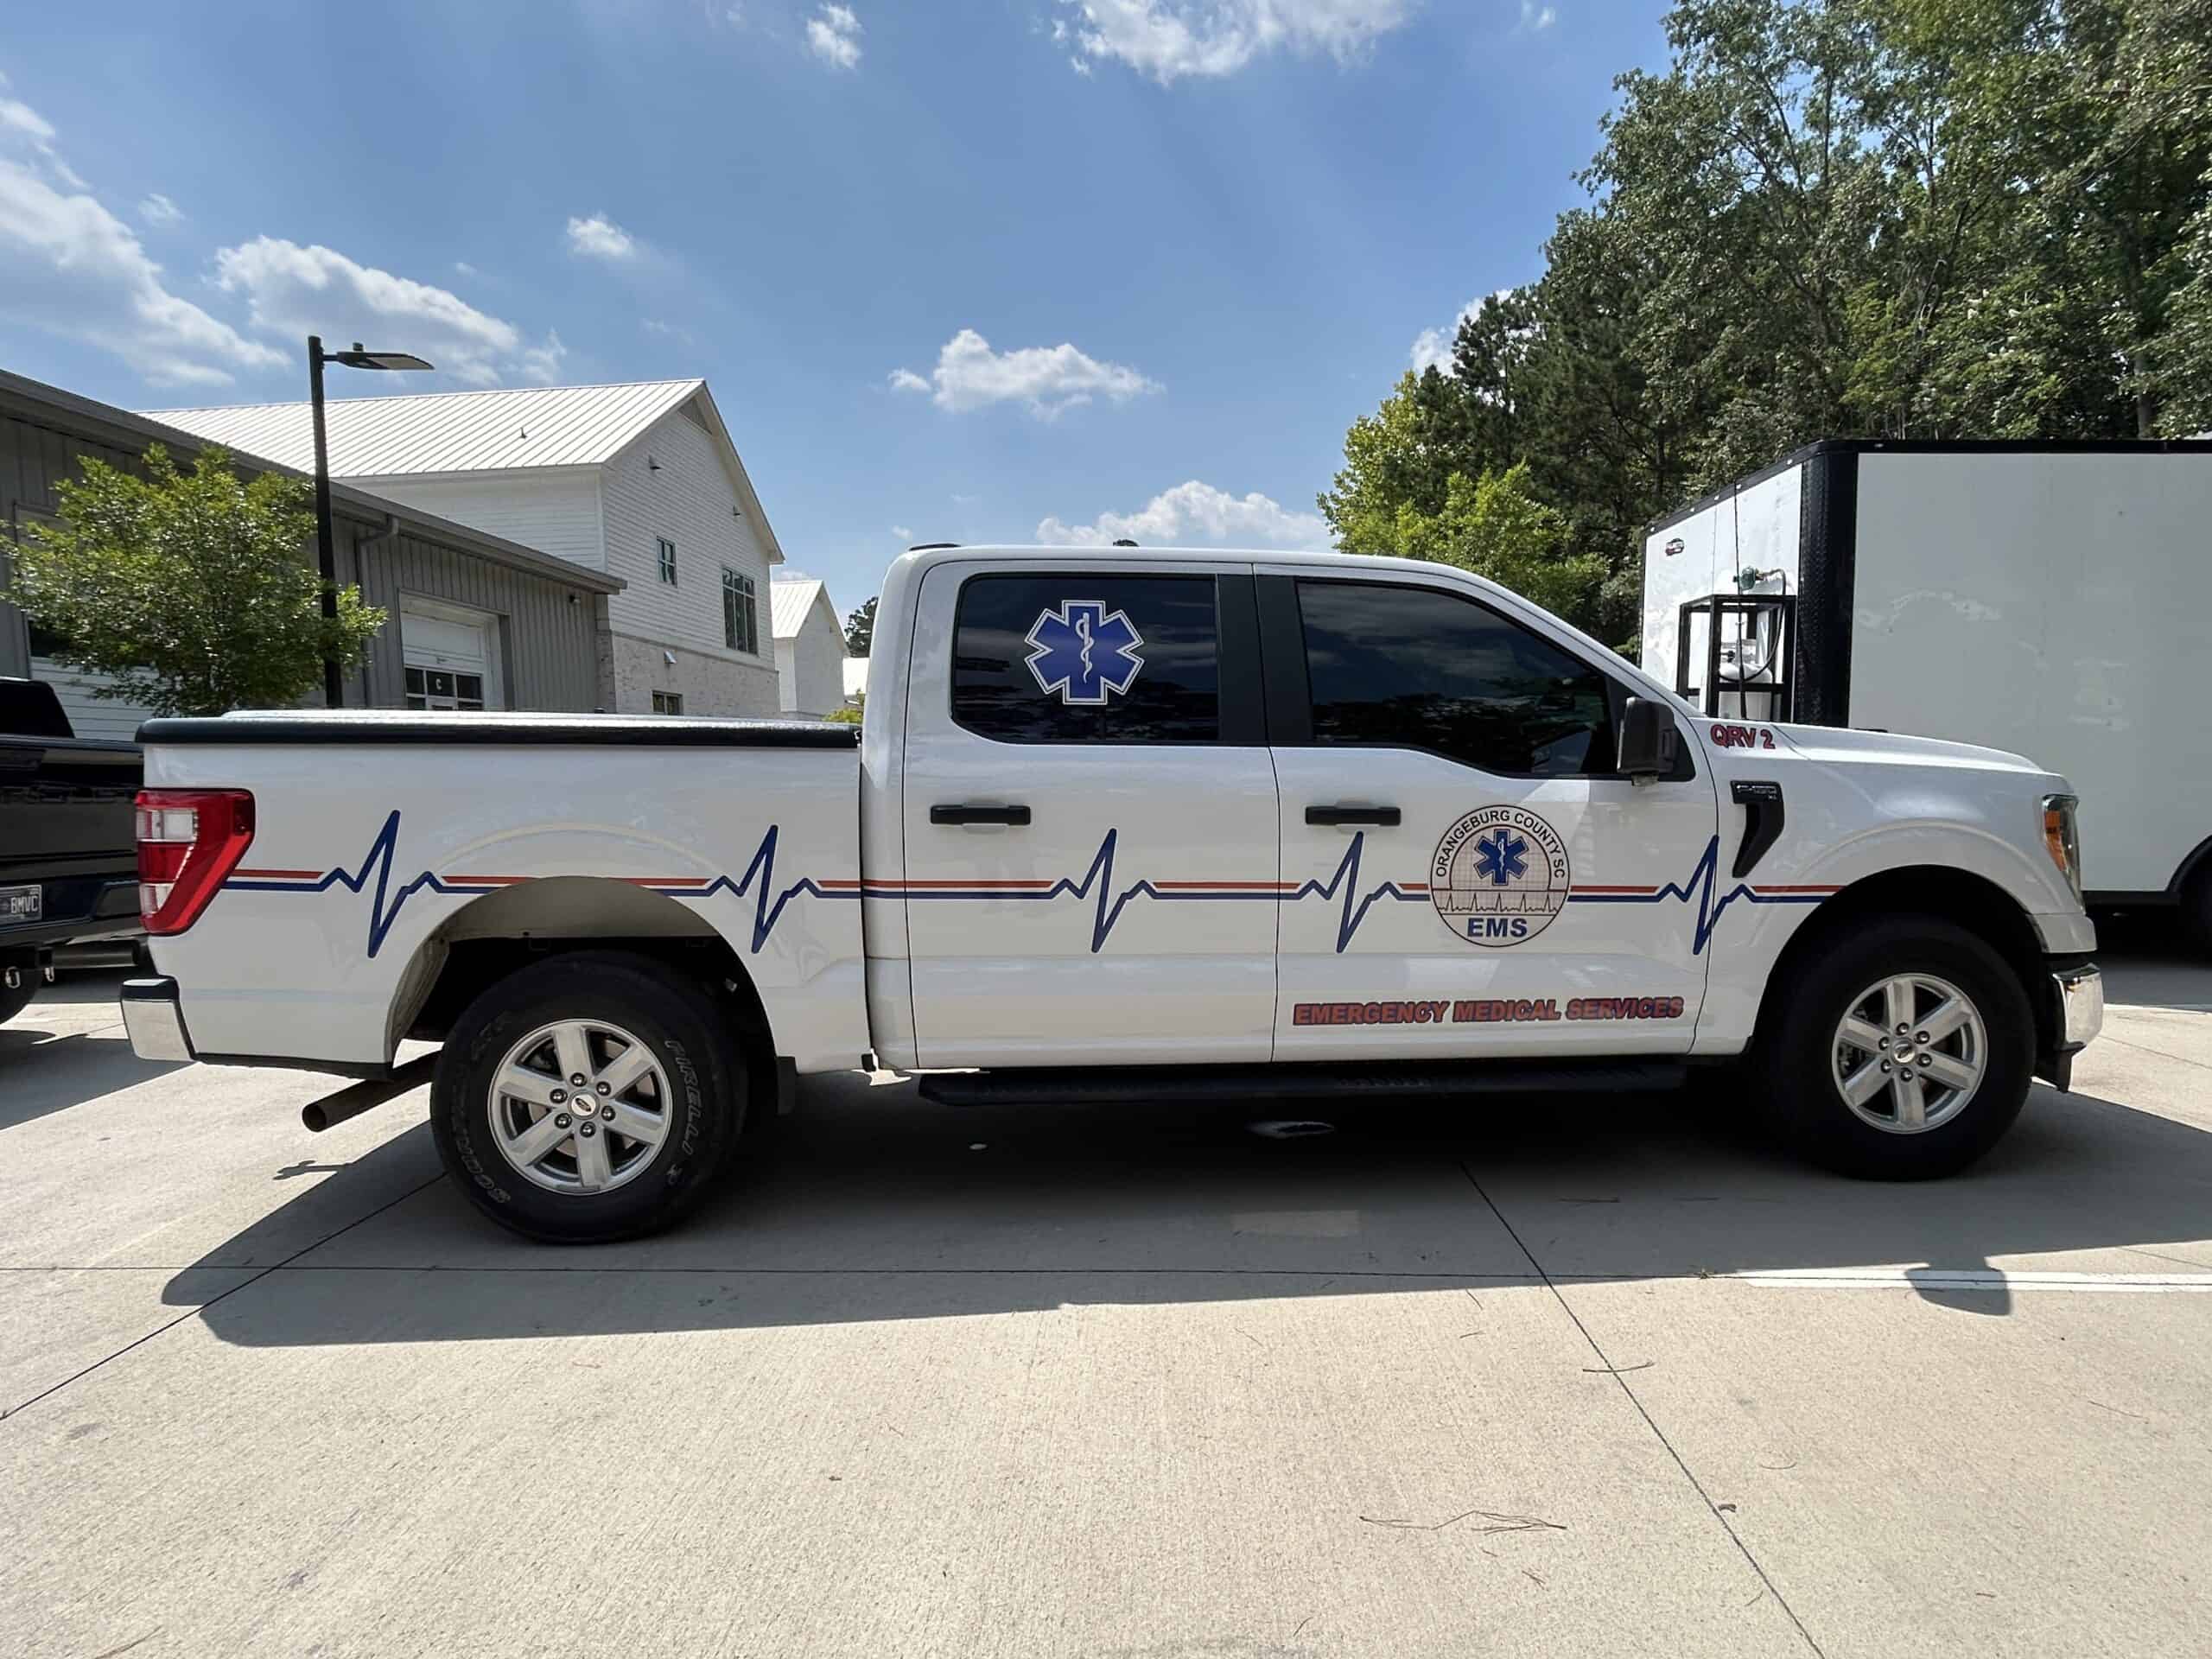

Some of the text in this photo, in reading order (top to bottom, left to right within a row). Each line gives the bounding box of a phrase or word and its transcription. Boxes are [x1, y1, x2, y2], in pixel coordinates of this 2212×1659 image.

[1710, 724, 1777, 750] QRV 2
[1435, 810, 1566, 879] ORANGEBURG COUNTY SC
[1467, 918, 1529, 938] EMS
[1293, 996, 1685, 1026] EMERGENCY MEDICAL SERVICES
